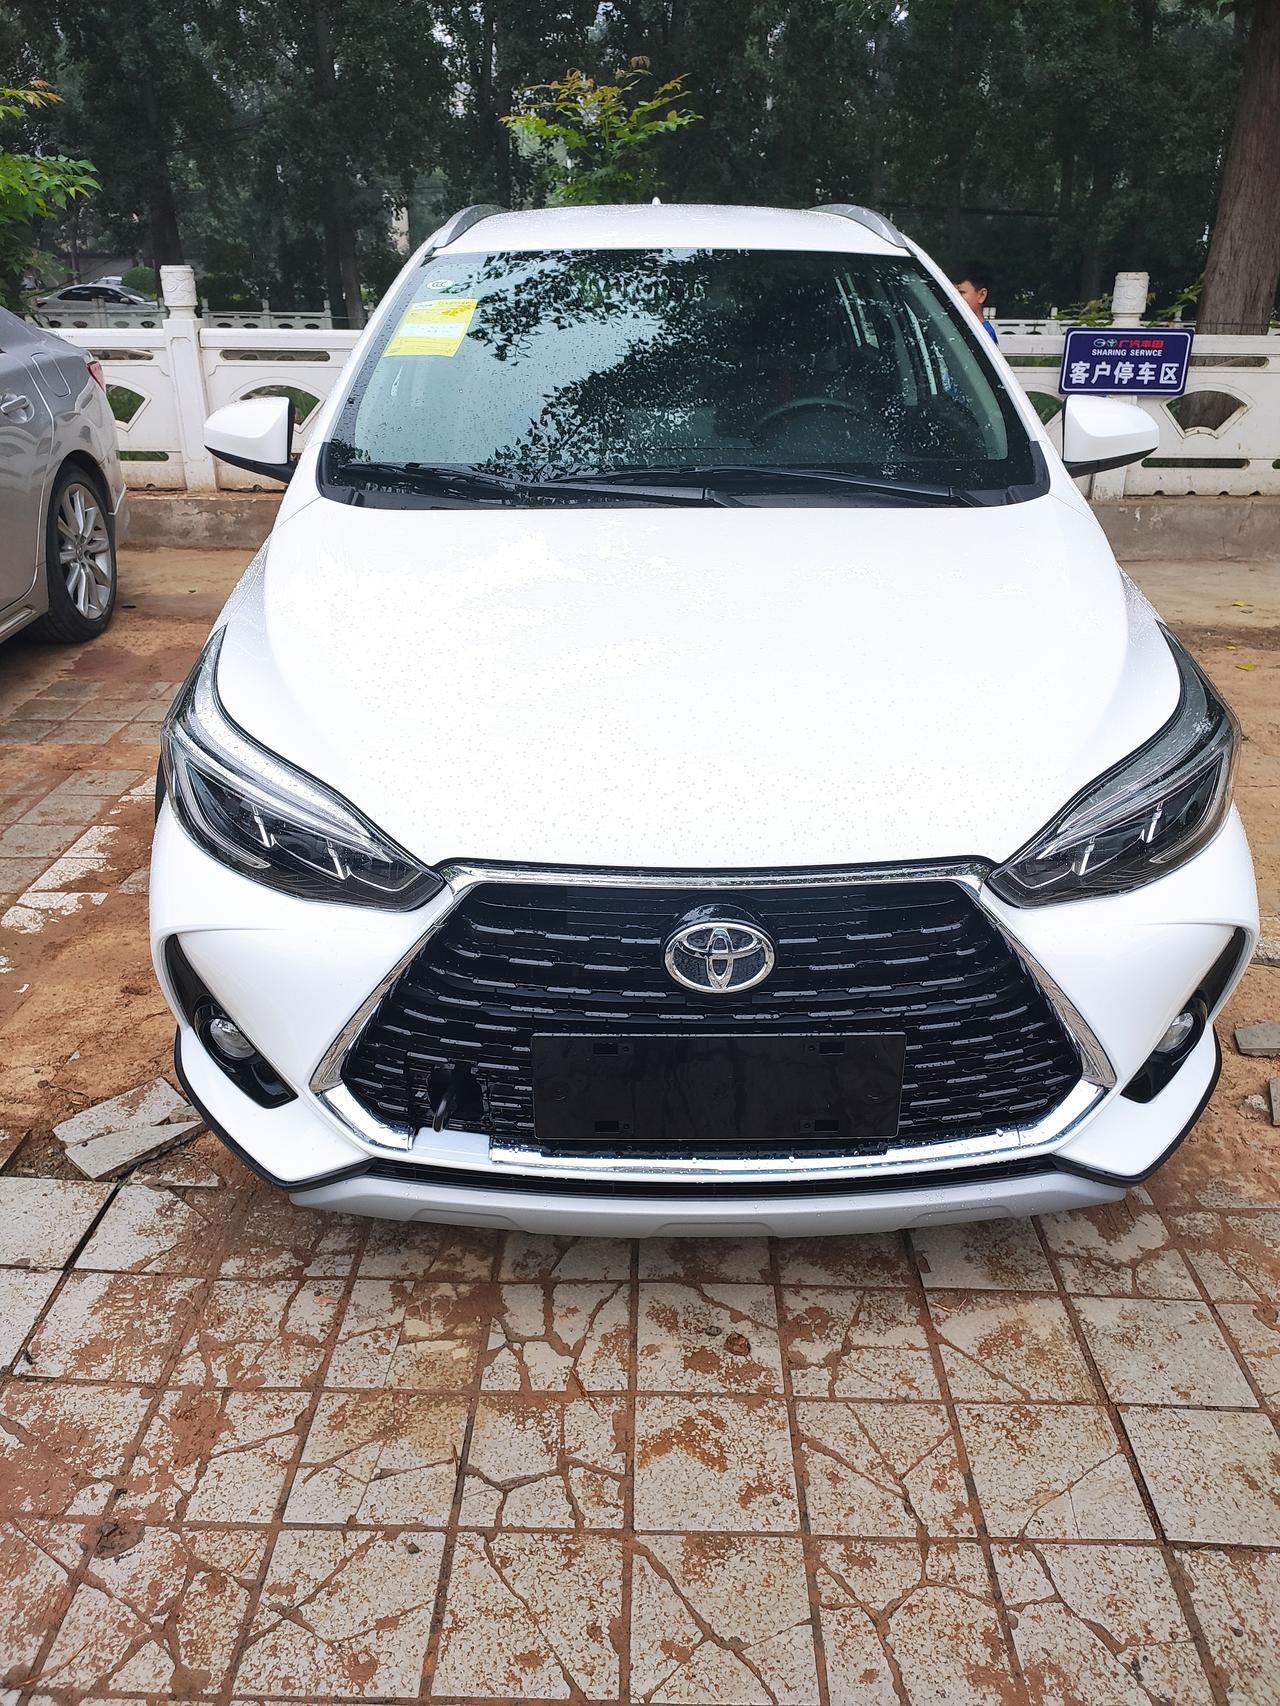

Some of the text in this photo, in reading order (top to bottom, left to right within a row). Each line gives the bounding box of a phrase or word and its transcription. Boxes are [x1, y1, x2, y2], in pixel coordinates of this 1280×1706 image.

[1069, 361, 1180, 385] 客户停车区
